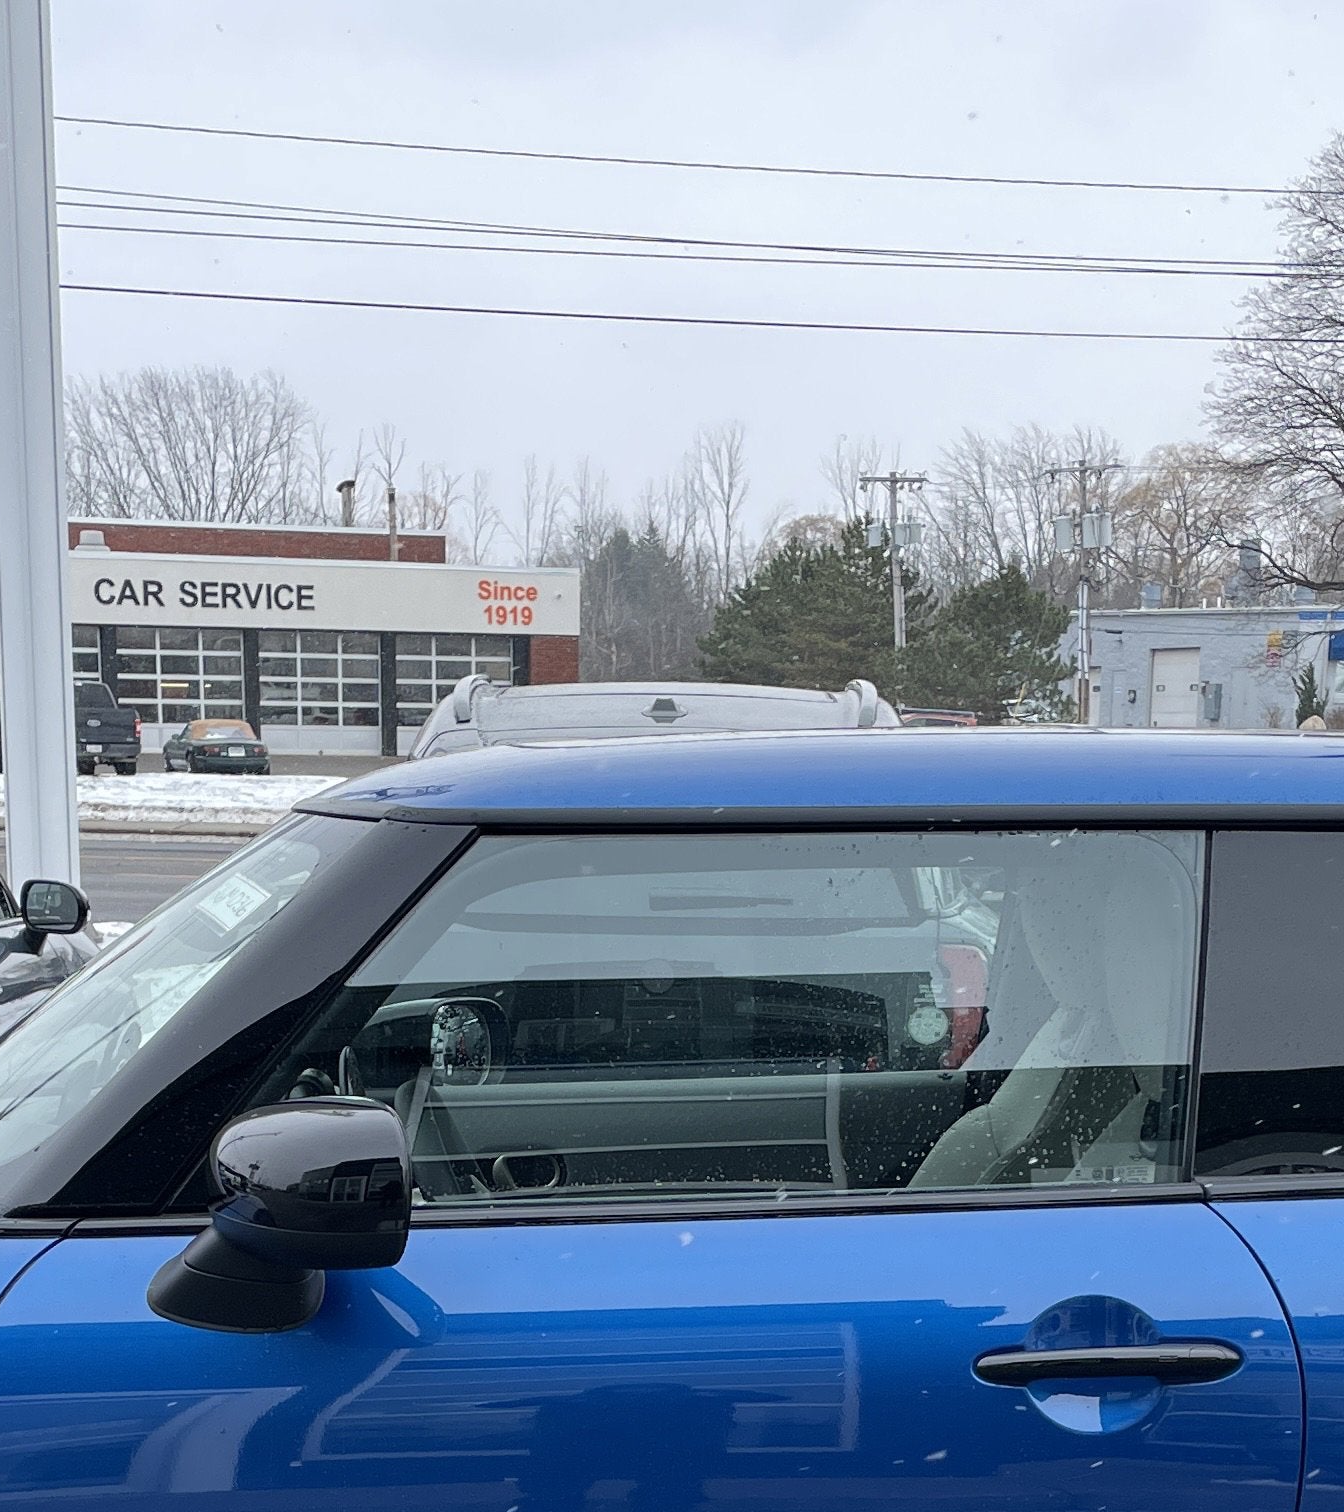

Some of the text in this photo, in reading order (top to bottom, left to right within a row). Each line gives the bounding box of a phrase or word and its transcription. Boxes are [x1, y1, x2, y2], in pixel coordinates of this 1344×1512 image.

[94, 577, 316, 611] CAR SERVICE
[477, 580, 538, 602] Since
[483, 604, 534, 626] 1919
